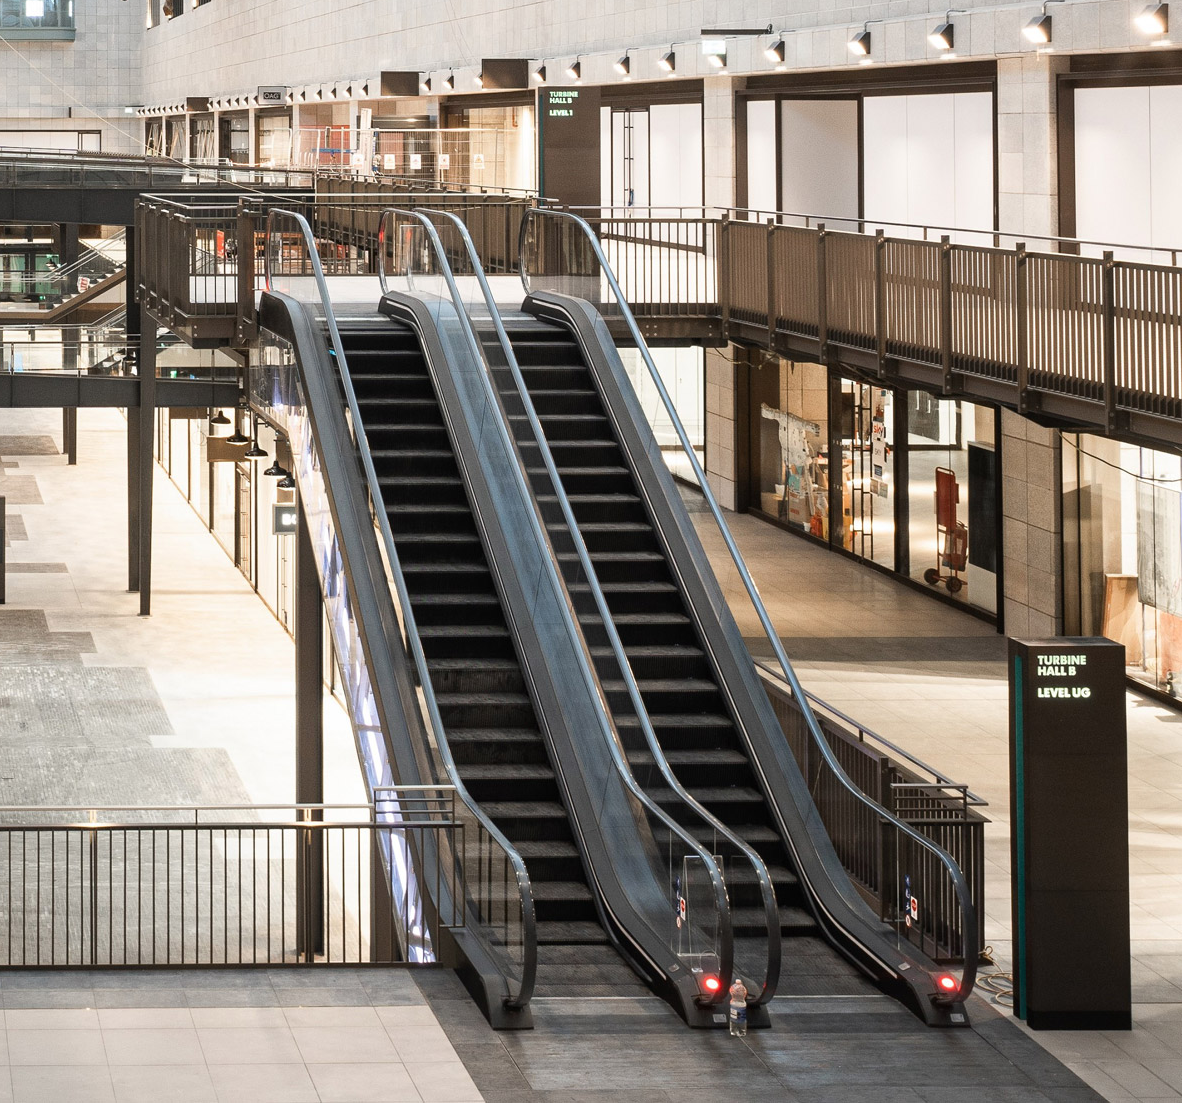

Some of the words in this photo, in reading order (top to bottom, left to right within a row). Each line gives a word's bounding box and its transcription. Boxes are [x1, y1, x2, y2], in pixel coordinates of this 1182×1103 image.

[1037, 655, 1086, 665] TURBINE
[1037, 666, 1066, 676] HALL
[1068, 666, 1076, 676] B
[1037, 687, 1071, 698] LEVEL
[1072, 687, 1091, 698] UG
